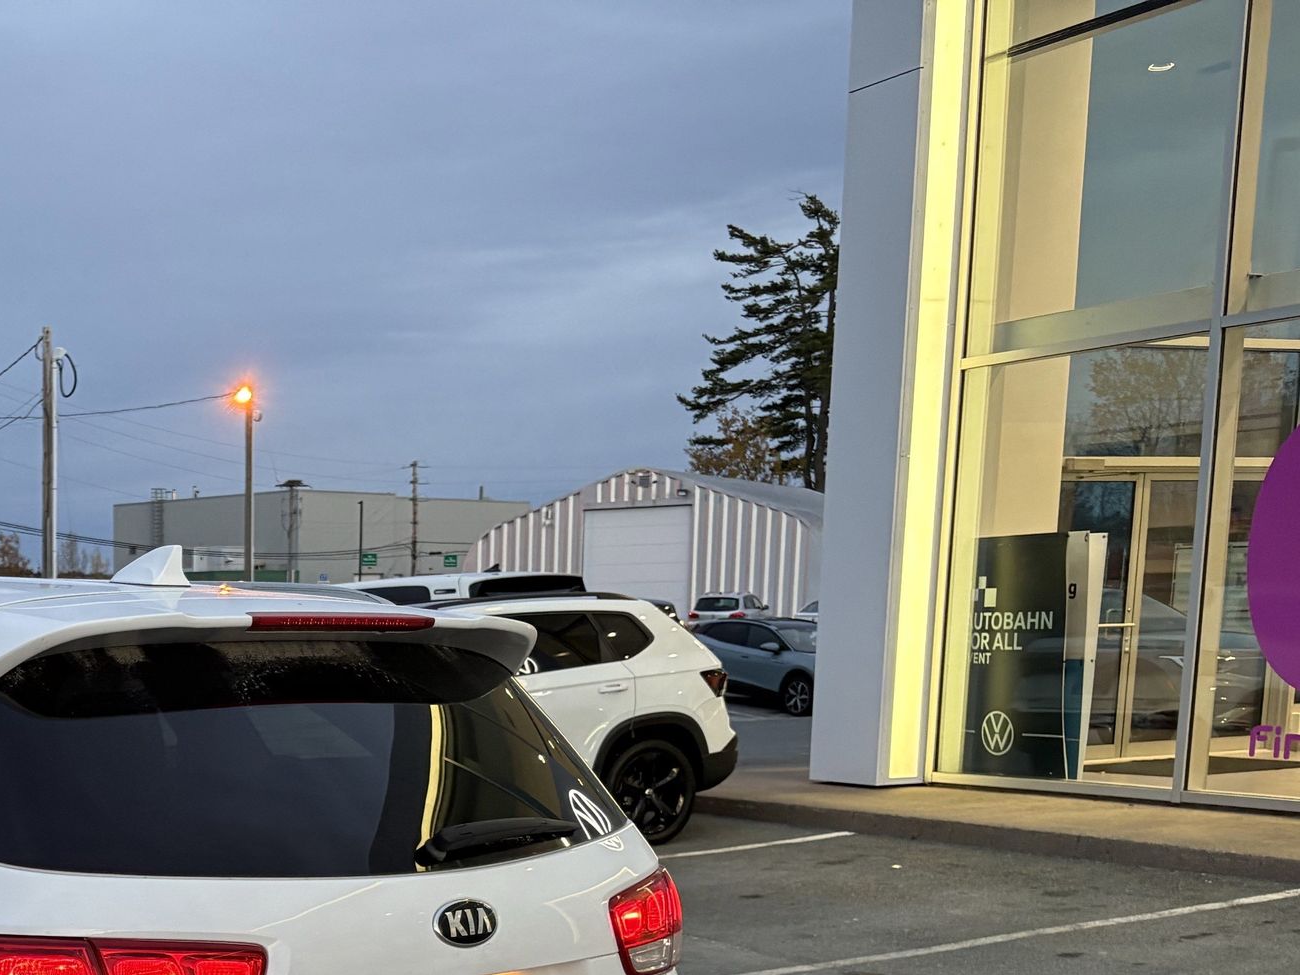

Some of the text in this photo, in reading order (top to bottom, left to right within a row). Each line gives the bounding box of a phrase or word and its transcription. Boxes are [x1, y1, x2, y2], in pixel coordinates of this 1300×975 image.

[971, 611, 1054, 631] UTOBAHN
[970, 632, 1023, 651] OR ALL
[444, 907, 493, 938] KIA
